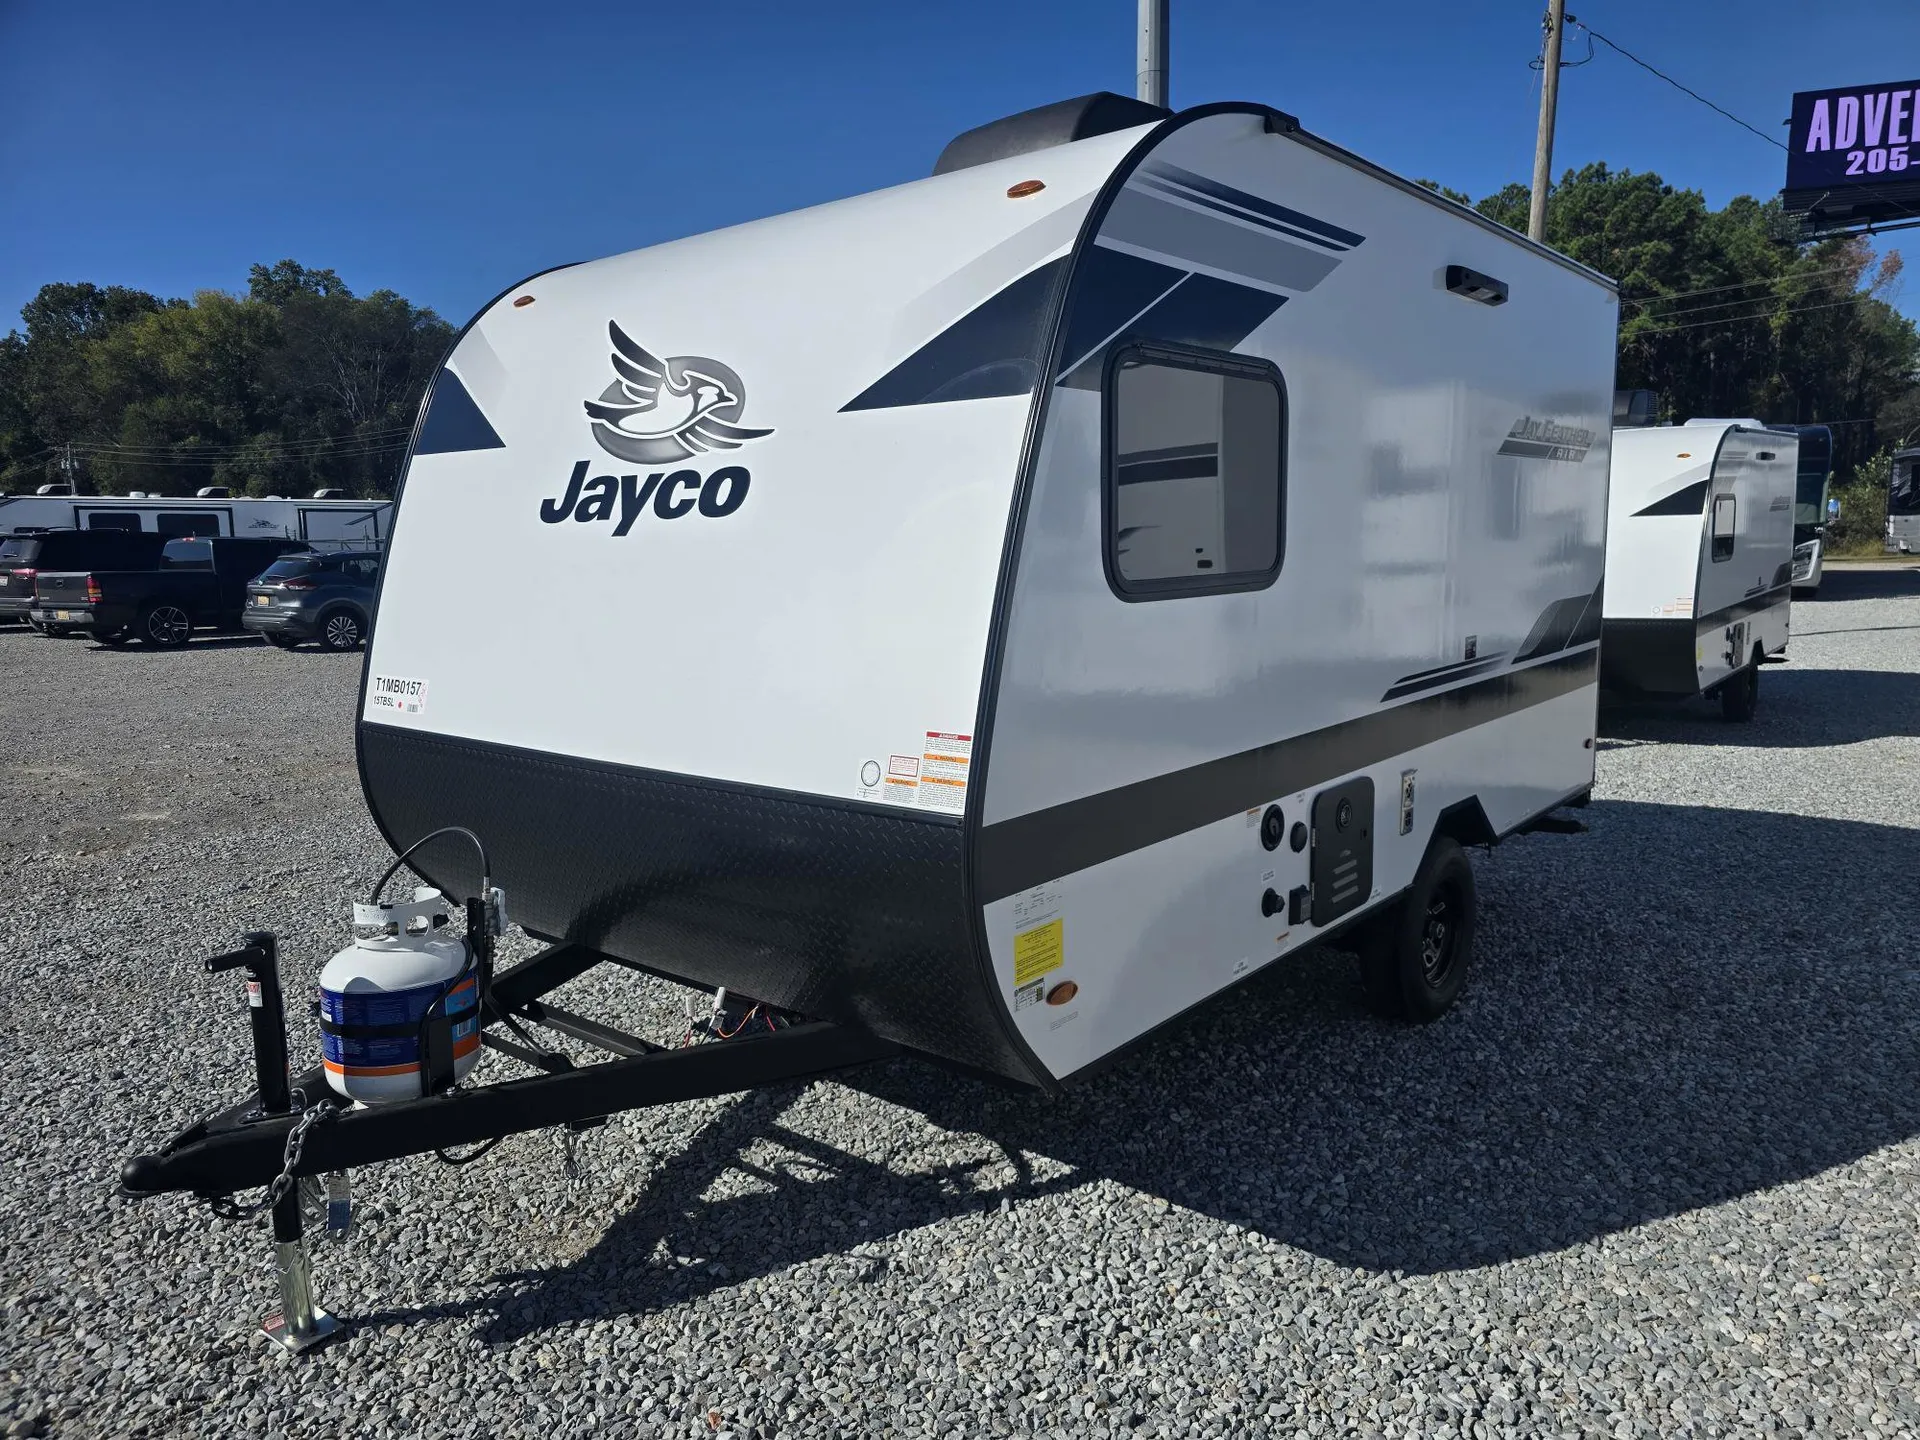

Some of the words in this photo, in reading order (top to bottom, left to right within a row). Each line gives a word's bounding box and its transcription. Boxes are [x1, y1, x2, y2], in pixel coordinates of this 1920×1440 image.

[1846, 146, 1920, 176] 205-
[540, 460, 751, 537] Jayco
[376, 677, 422, 696] T1MB0157
